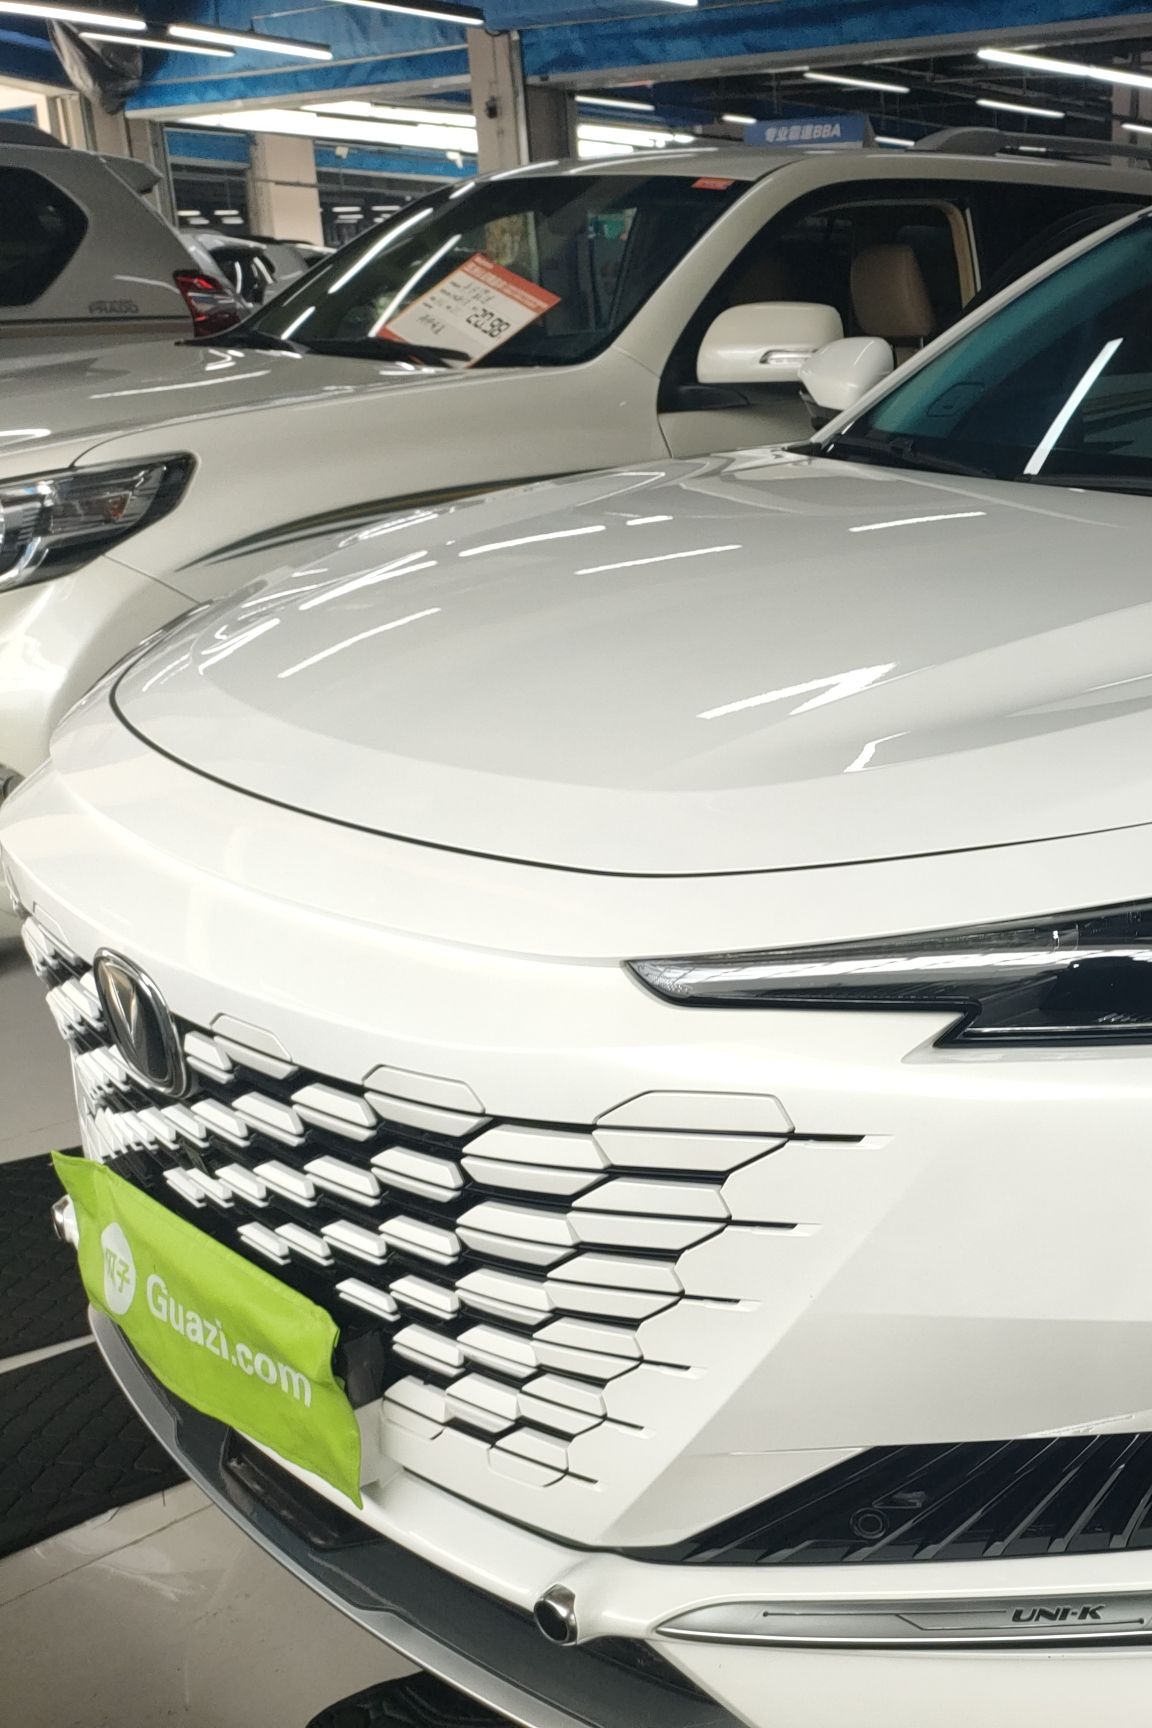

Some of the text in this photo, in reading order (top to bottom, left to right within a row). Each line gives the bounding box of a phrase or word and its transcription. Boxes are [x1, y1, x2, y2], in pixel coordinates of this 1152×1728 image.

[88, 300, 139, 314] PRADO
[146, 1273, 312, 1409] Guazi.com
[1011, 1604, 1105, 1622] UNI-K
